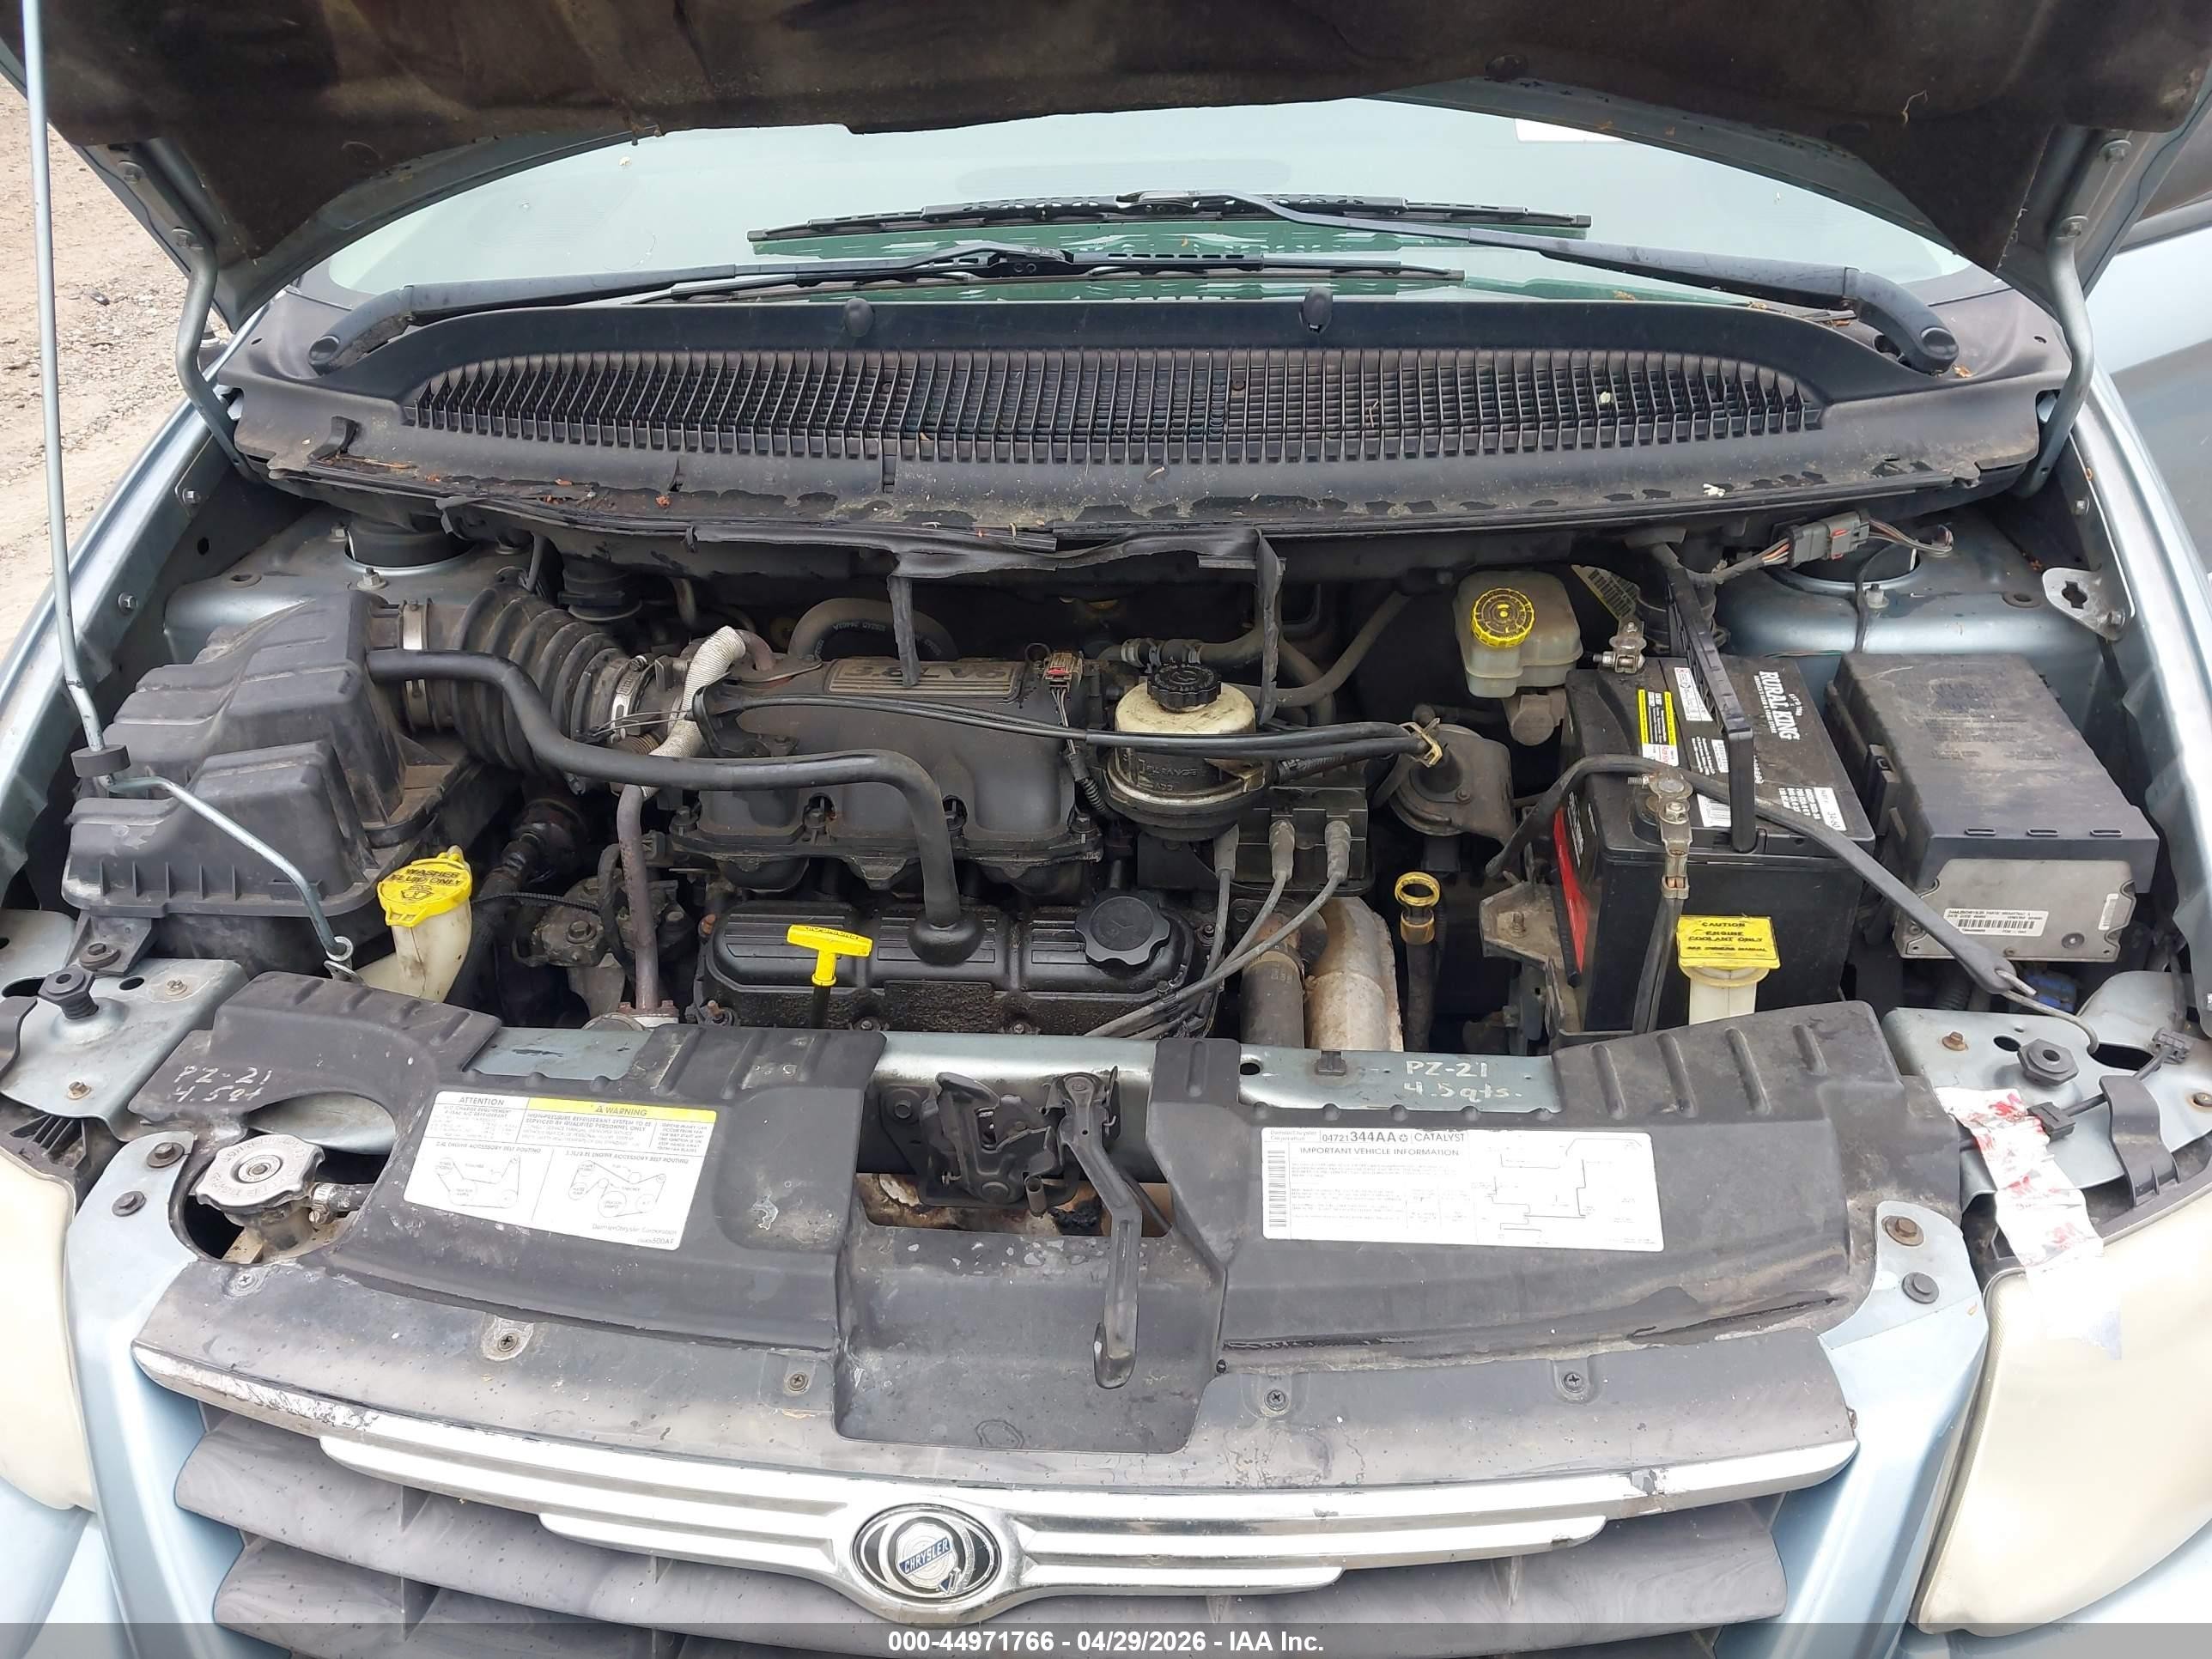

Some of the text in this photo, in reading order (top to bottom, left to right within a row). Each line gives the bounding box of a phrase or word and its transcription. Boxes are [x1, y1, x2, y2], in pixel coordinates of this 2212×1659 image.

[1759, 671, 1800, 740] RURAL KING
[406, 868, 460, 878] WASHER
[390, 874, 462, 886] FLUID ONLY
[1406, 1060, 1488, 1078] PZ-21
[173, 1065, 272, 1085] PZ-21
[459, 1097, 505, 1106] ATTENTION
[605, 1107, 647, 1116] WARNING
[564, 1120, 594, 1128] QUALIFIED
[572, 1115, 611, 1123] REFRIGERANT
[1414, 1133, 1465, 1142] CATALYST
[1300, 1146, 1352, 1155] IMPORTANT
[592, 1223, 677, 1235] DaimlerChrysler Corporation
[904, 1539, 950, 1574] CHRYSLER
